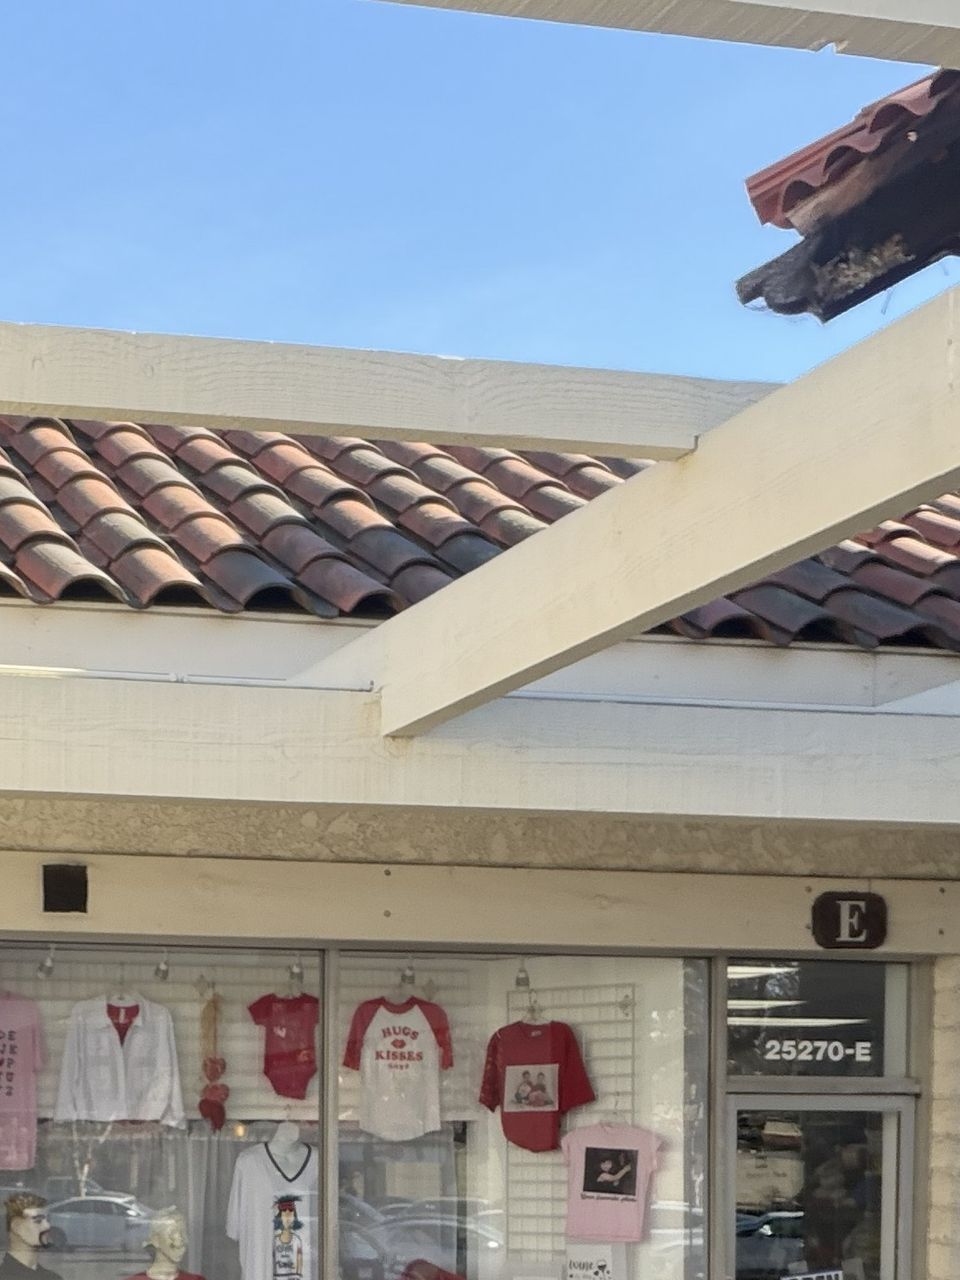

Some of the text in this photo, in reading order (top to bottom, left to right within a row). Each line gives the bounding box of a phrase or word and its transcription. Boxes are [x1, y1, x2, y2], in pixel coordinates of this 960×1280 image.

[835, 900, 867, 942] E
[382, 1026, 419, 1040] HUGS
[375, 1050, 423, 1061] KISSES
[764, 1040, 871, 1062] 25270-E
